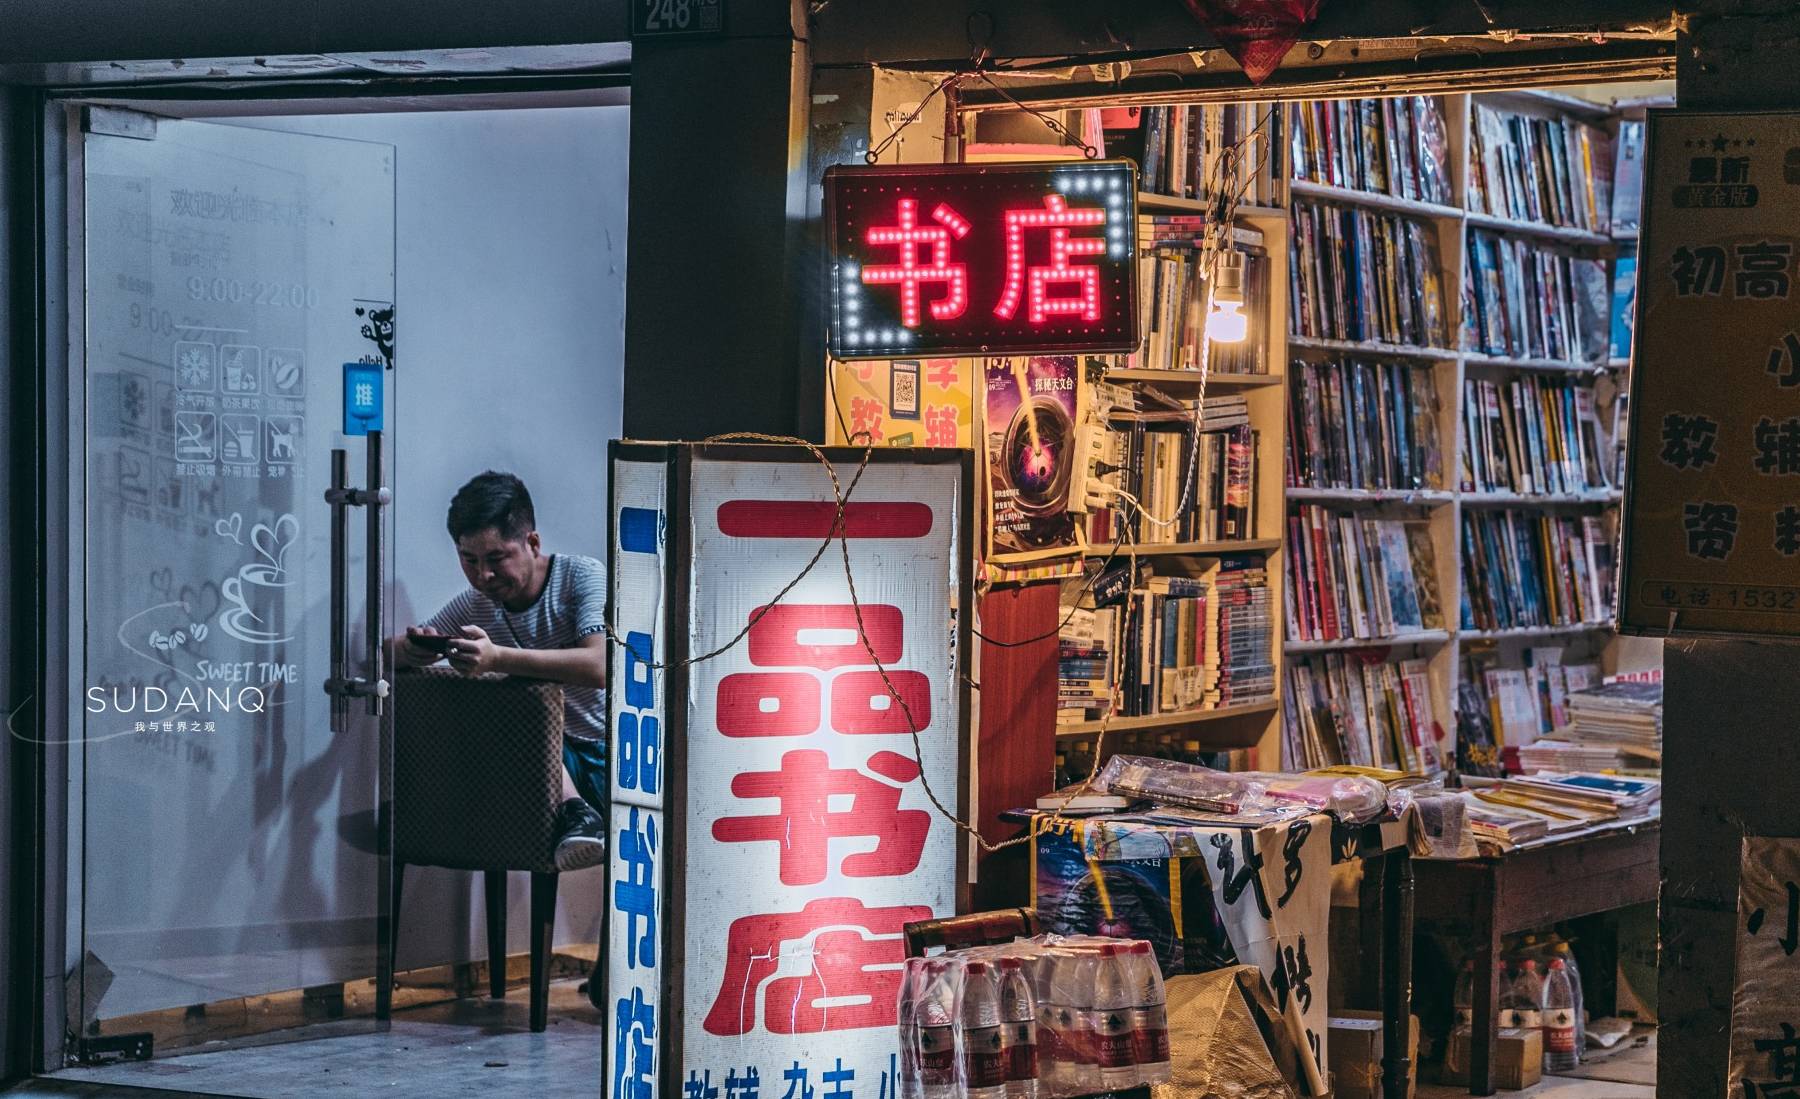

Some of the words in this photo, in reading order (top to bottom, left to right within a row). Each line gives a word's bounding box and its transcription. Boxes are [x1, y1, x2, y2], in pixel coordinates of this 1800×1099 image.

[862, 194, 1106, 328] 书店
[1671, 240, 1791, 299] 初高
[355, 383, 374, 406] 推
[1035, 377, 1073, 391] 探秘天文台
[196, 660, 254, 682] SWEET
[258, 662, 298, 684] TIME
[703, 500, 934, 1035] 一品书店
